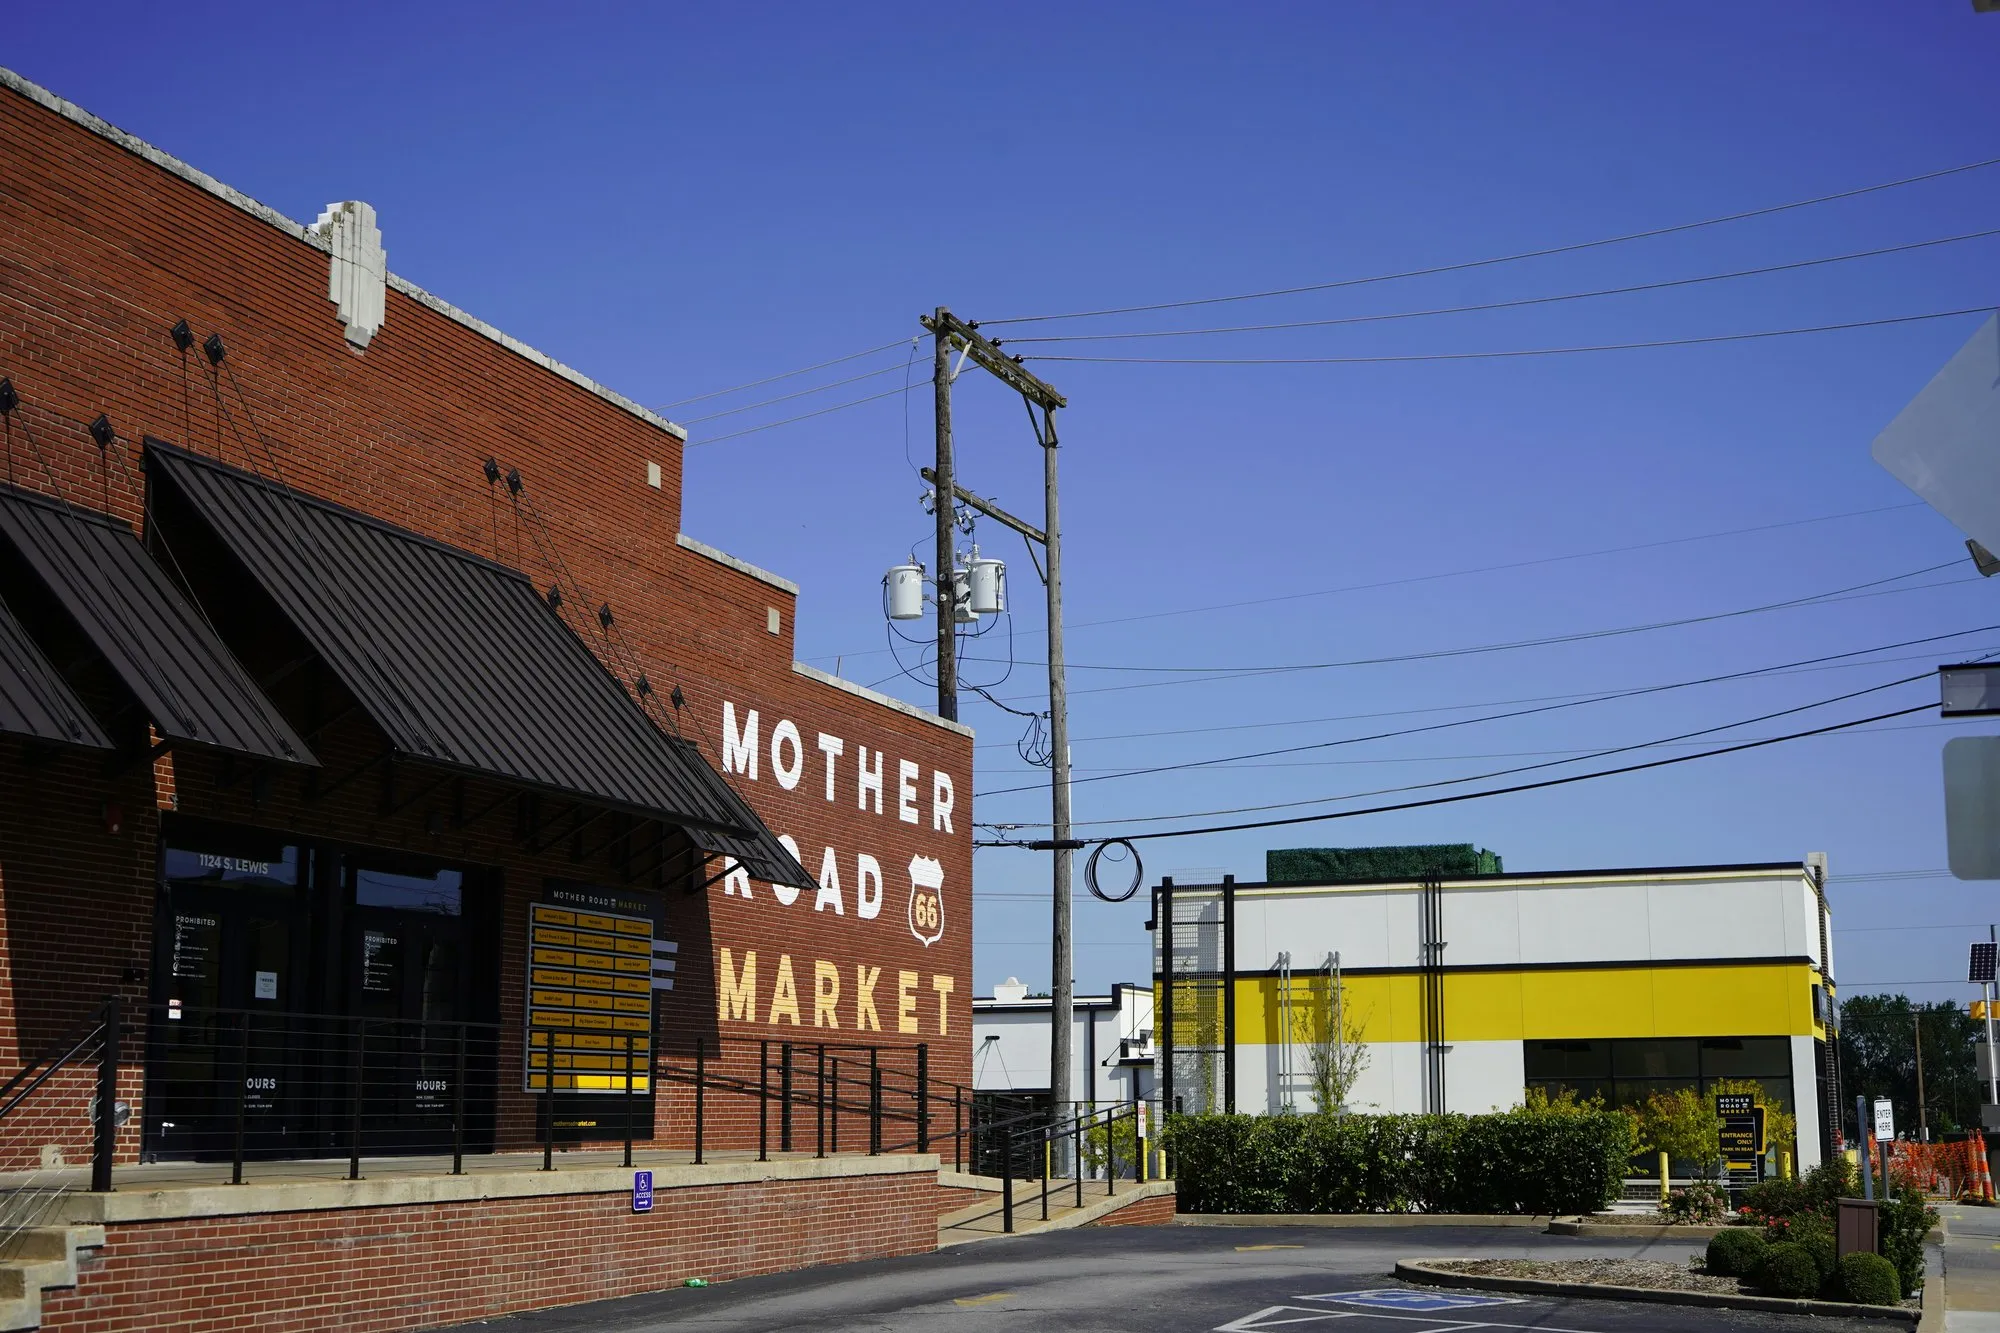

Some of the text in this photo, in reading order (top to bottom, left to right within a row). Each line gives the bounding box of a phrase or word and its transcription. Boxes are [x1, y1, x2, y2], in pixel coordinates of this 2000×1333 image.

[722, 700, 955, 834] MOTHER
[199, 854, 269, 875] 1124 S. LEWIS
[553, 890, 648, 912] MOTHER ROAD MARKET
[915, 893, 938, 929] 66
[175, 915, 216, 927] PROHIBITED
[364, 935, 398, 945] PROHIBITED
[719, 947, 955, 1036] MARKET
[246, 1077, 276, 1089] OURS
[416, 1080, 447, 1091] HOURS
[1876, 1109, 1891, 1119] ENTER
[1878, 1121, 1891, 1131] HERE
